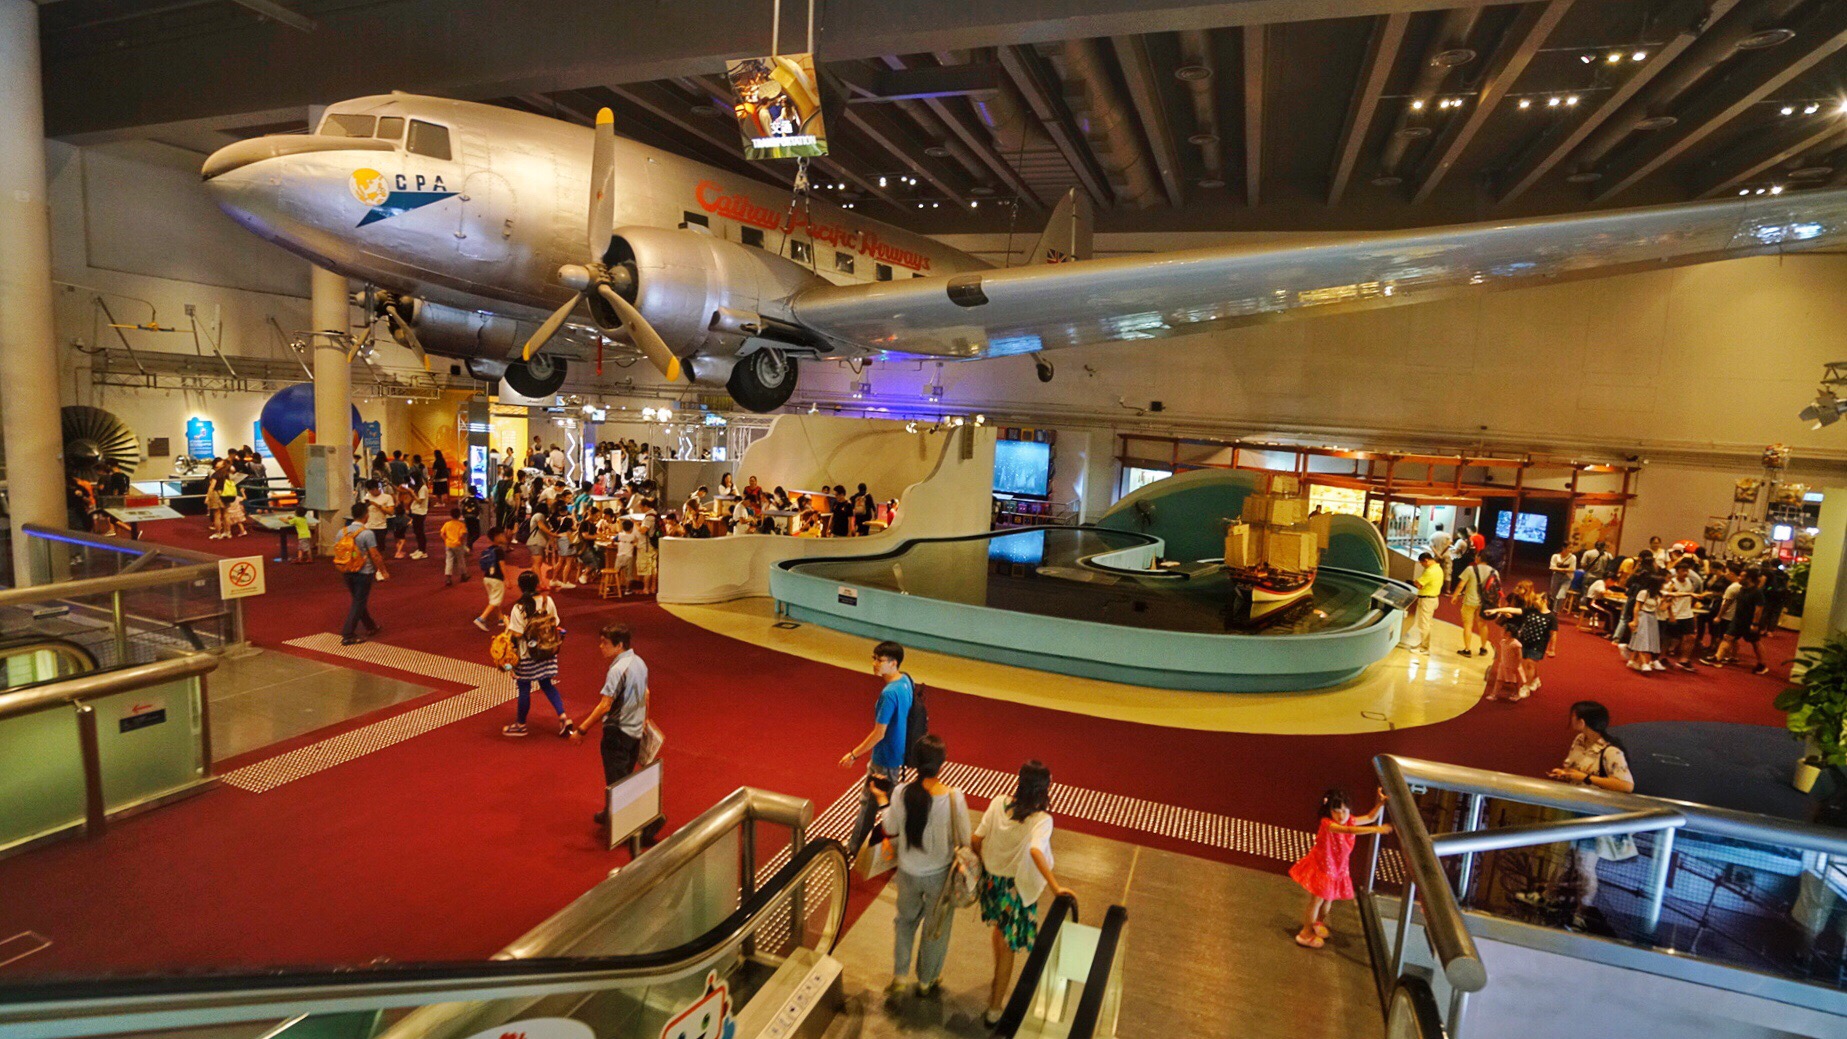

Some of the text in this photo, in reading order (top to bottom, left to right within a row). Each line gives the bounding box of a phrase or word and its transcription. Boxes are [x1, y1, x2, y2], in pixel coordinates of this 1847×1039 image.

[752, 135, 816, 148] TRANSPORTATION
[395, 174, 447, 191] CPA
[695, 179, 931, 271] Cathay Pacific Airways
